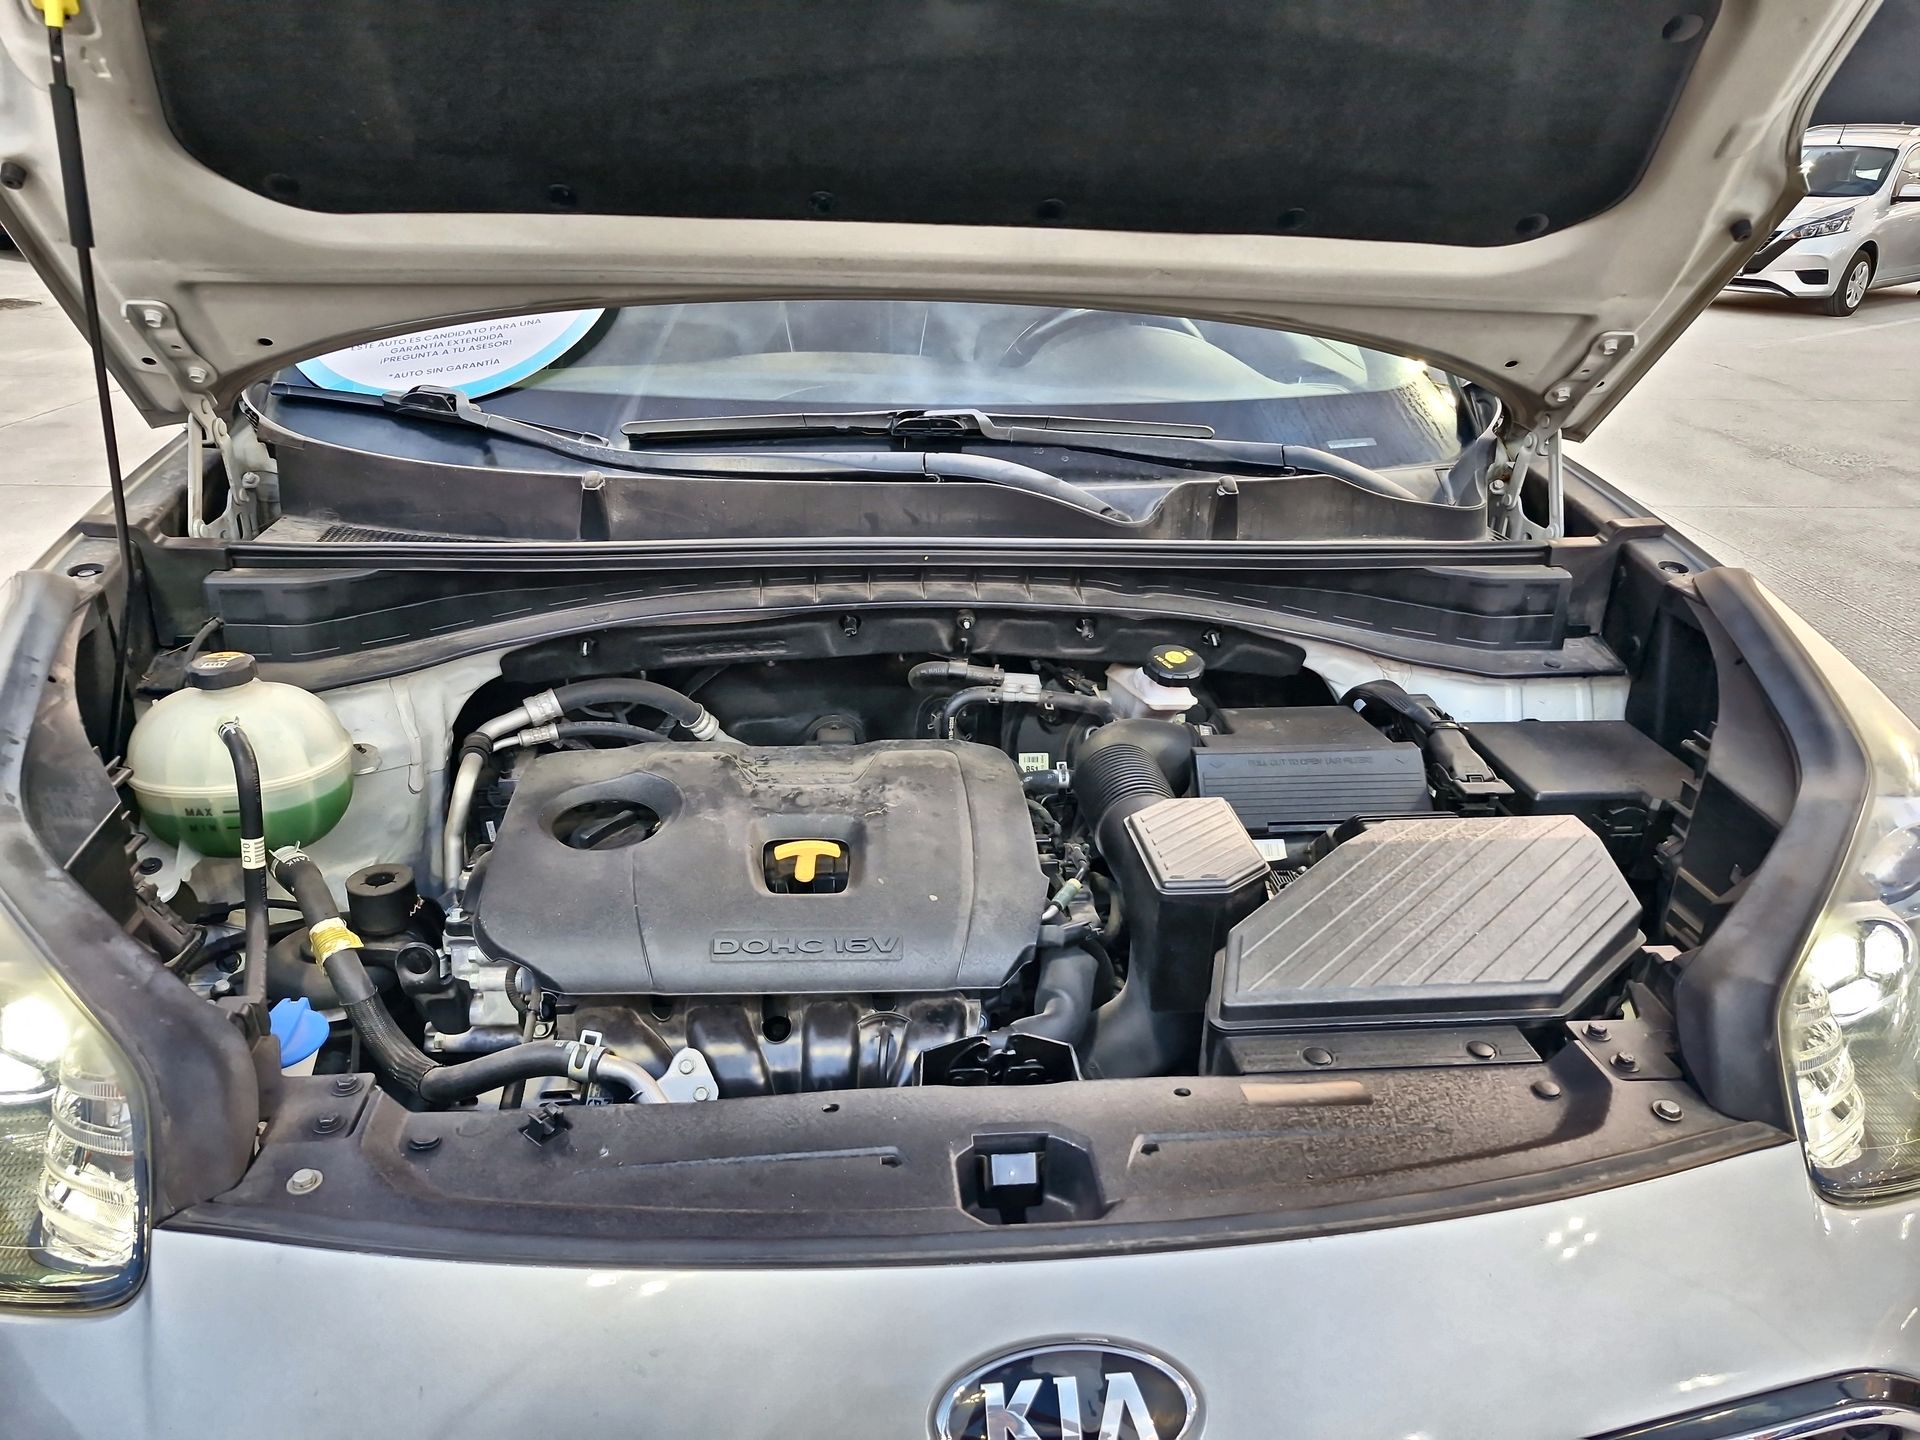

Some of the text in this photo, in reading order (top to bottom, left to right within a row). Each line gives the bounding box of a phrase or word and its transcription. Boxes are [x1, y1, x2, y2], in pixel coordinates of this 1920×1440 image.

[378, 338, 407, 347] AUTO
[424, 327, 487, 341] CANDIDATO
[489, 322, 517, 331] PARA
[520, 318, 542, 327] UNA
[390, 332, 504, 354] GARANTÍA EXTENDIDA
[380, 351, 438, 364] ¡PREGUNTA
[468, 339, 512, 351] ASESOR!
[426, 367, 443, 375] SIN
[446, 358, 500, 372] GARANTÍA
[184, 808, 213, 816] MAX
[713, 937, 900, 954] DOHC 16V
[979, 1371, 1160, 1440] KIA
